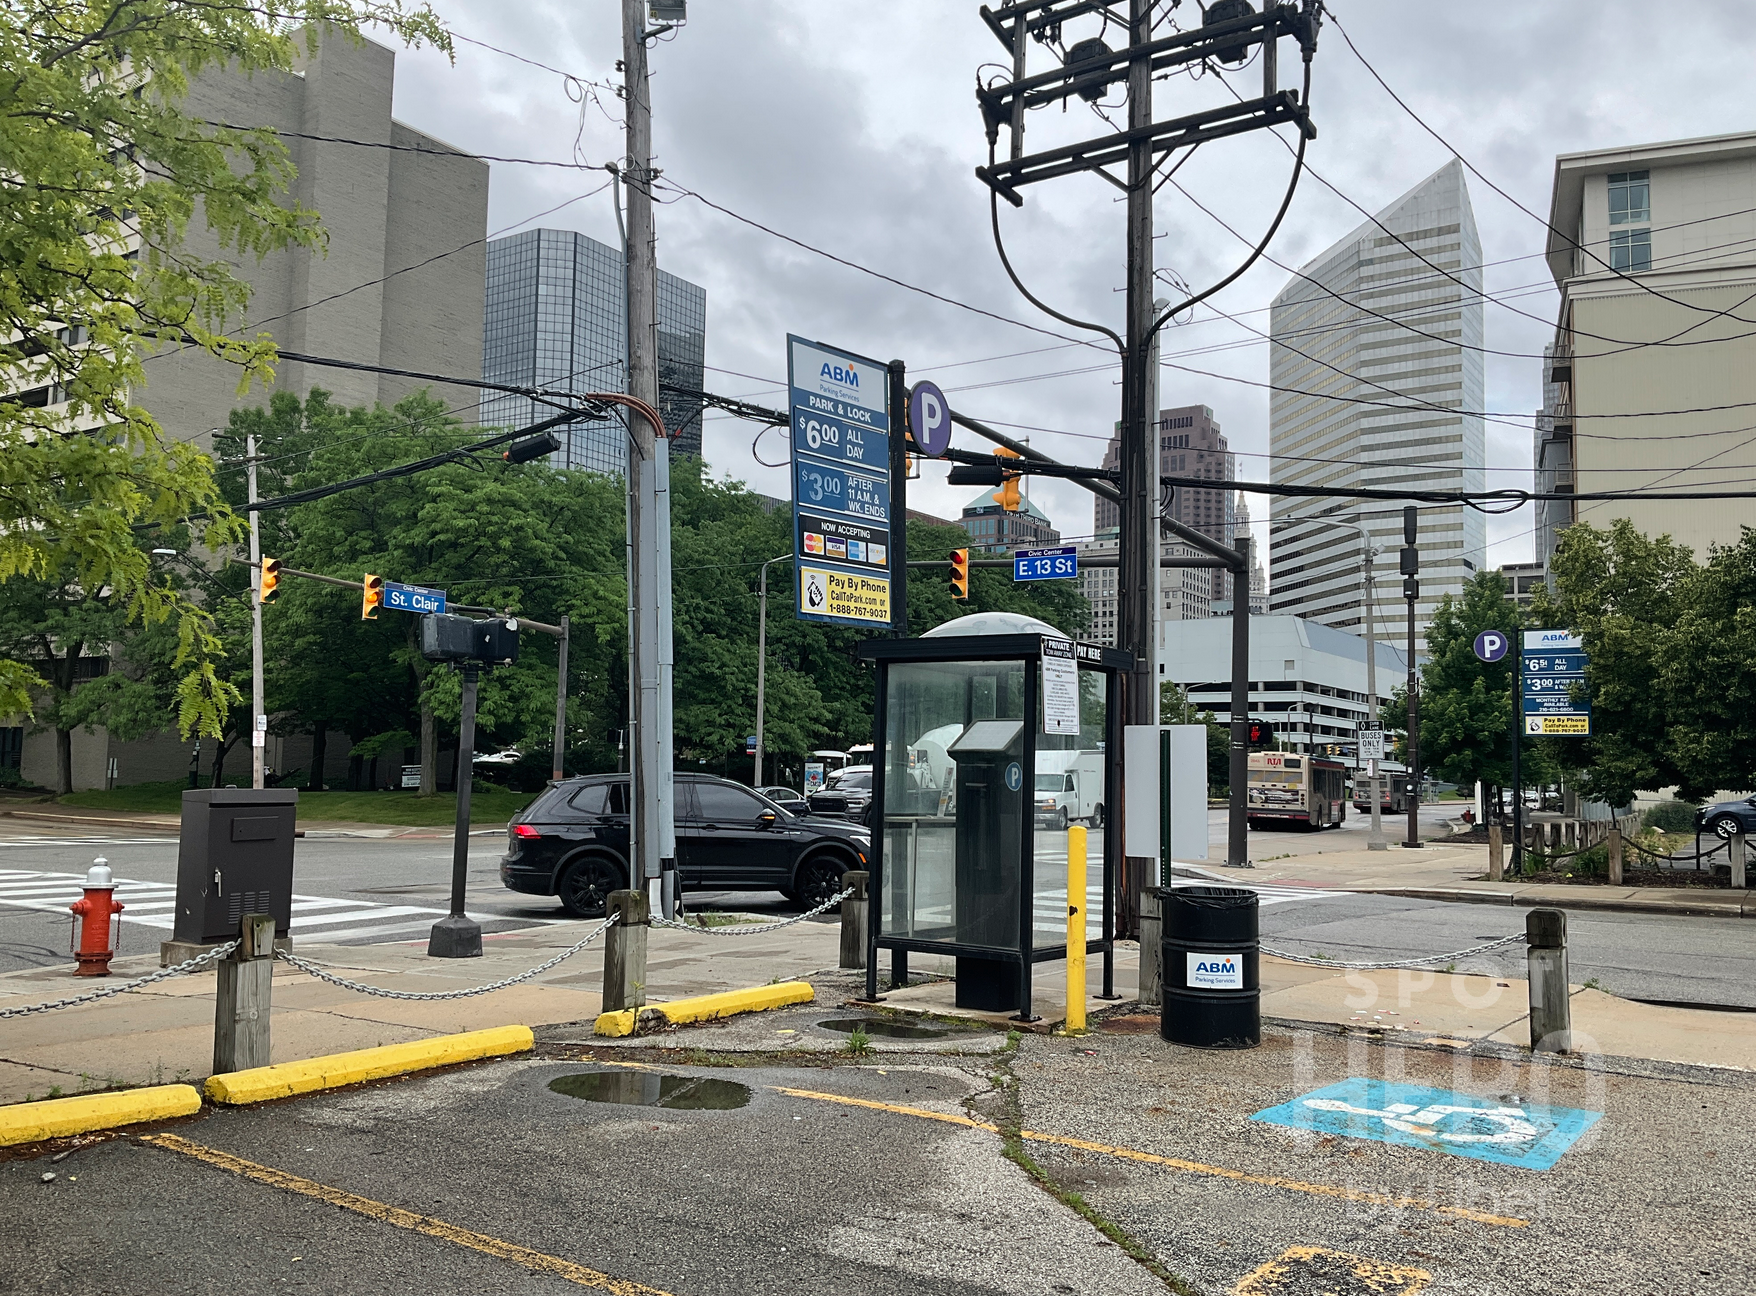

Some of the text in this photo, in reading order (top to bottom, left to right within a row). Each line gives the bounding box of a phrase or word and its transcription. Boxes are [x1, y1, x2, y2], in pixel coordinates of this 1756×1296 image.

[820, 363, 859, 388] ABM
[820, 384, 860, 403] Parking Services
[809, 395, 871, 423] PARK & LOCK
[921, 391, 942, 445] P
[846, 429, 864, 445] ALL
[846, 445, 864, 460] DAY
[848, 476, 873, 492] AFTER
[848, 489, 880, 505] 11 A.M. &
[848, 501, 886, 518] WK. ENDS
[1034, 517, 1047, 527] BANK
[821, 522, 871, 539] NOW ACCEPTING
[1019, 558, 1073, 576] E. 13 St
[828, 575, 887, 593] Pay By Phone
[391, 591, 439, 611] St. Clair
[831, 591, 886, 607] CallToPark.com or
[829, 603, 888, 619] 1-888-767-9037
[1048, 640, 1070, 651] PRIVATE
[1541, 634, 1569, 642] ABM
[1076, 645, 1087, 658] PAY
[1087, 647, 1101, 661] HERE
[1483, 635, 1501, 658] P
[1360, 731, 1382, 740] BUSES
[1362, 739, 1381, 747] ONLY
[1267, 757, 1282, 765] RTA
[1011, 767, 1019, 787] P
[1195, 961, 1236, 974] ABM
[1195, 976, 1215, 984] Parking
